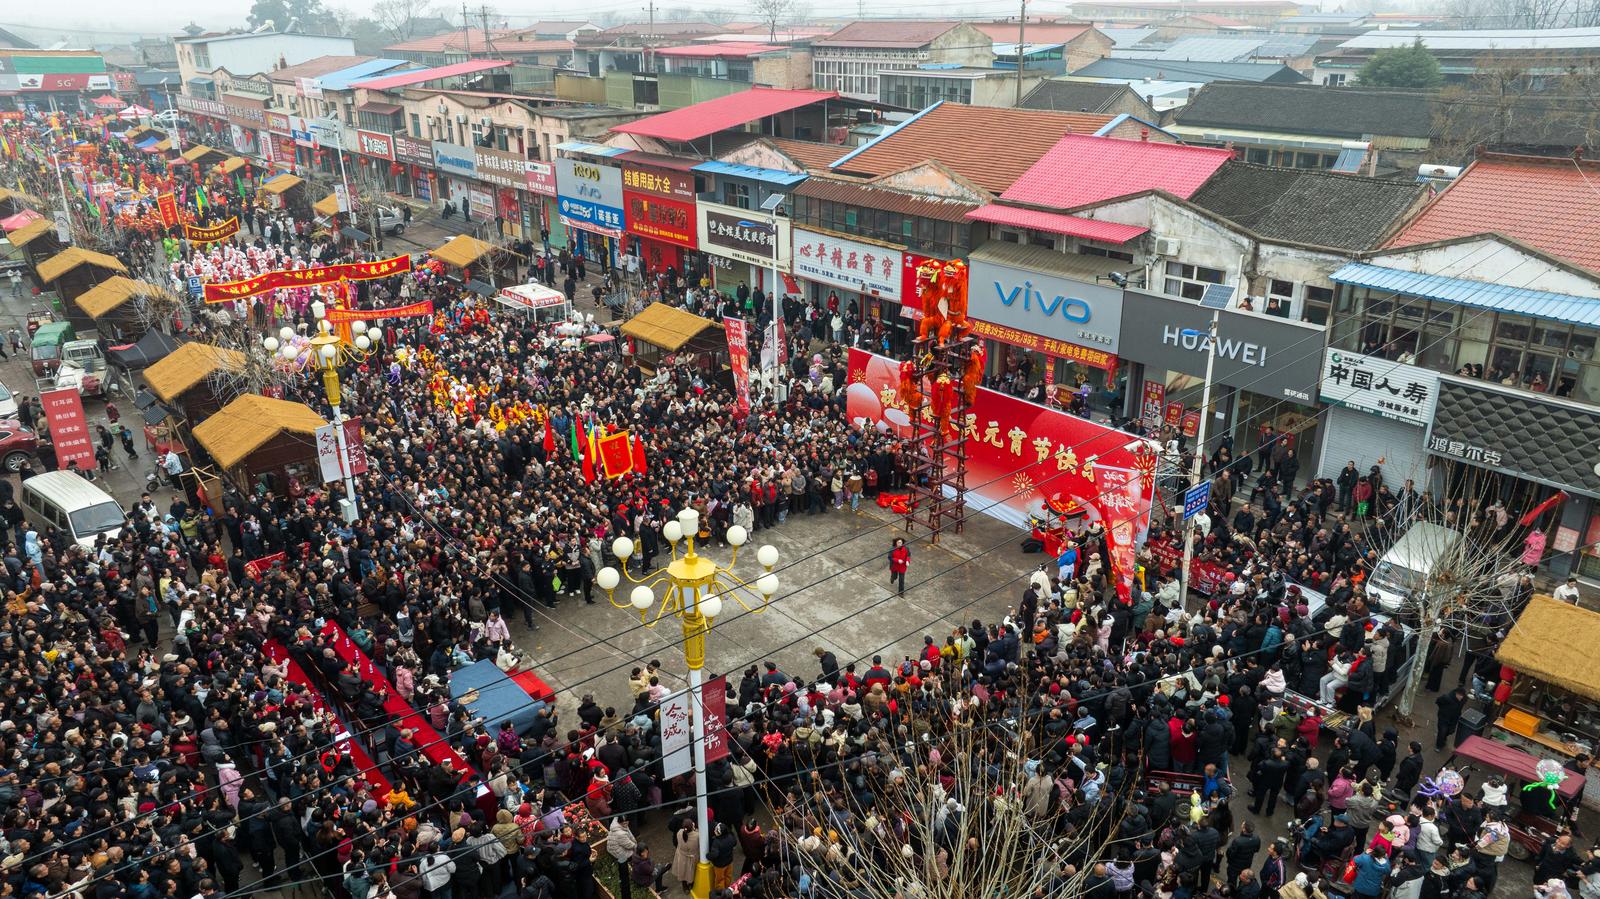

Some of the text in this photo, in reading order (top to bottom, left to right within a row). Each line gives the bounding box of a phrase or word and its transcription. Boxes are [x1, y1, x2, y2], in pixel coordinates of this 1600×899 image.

[573, 163, 600, 181] iQOO
[624, 170, 671, 193] 结婚用品大全
[994, 280, 1091, 324] vivo
[1043, 339, 1109, 366] 手机/家电免费带回家
[1162, 325, 1267, 367] HUAWEI
[1330, 364, 1429, 404] 中国人寿
[1377, 399, 1419, 416] 汾城服务部
[1430, 435, 1502, 466] 鸿星尔克
